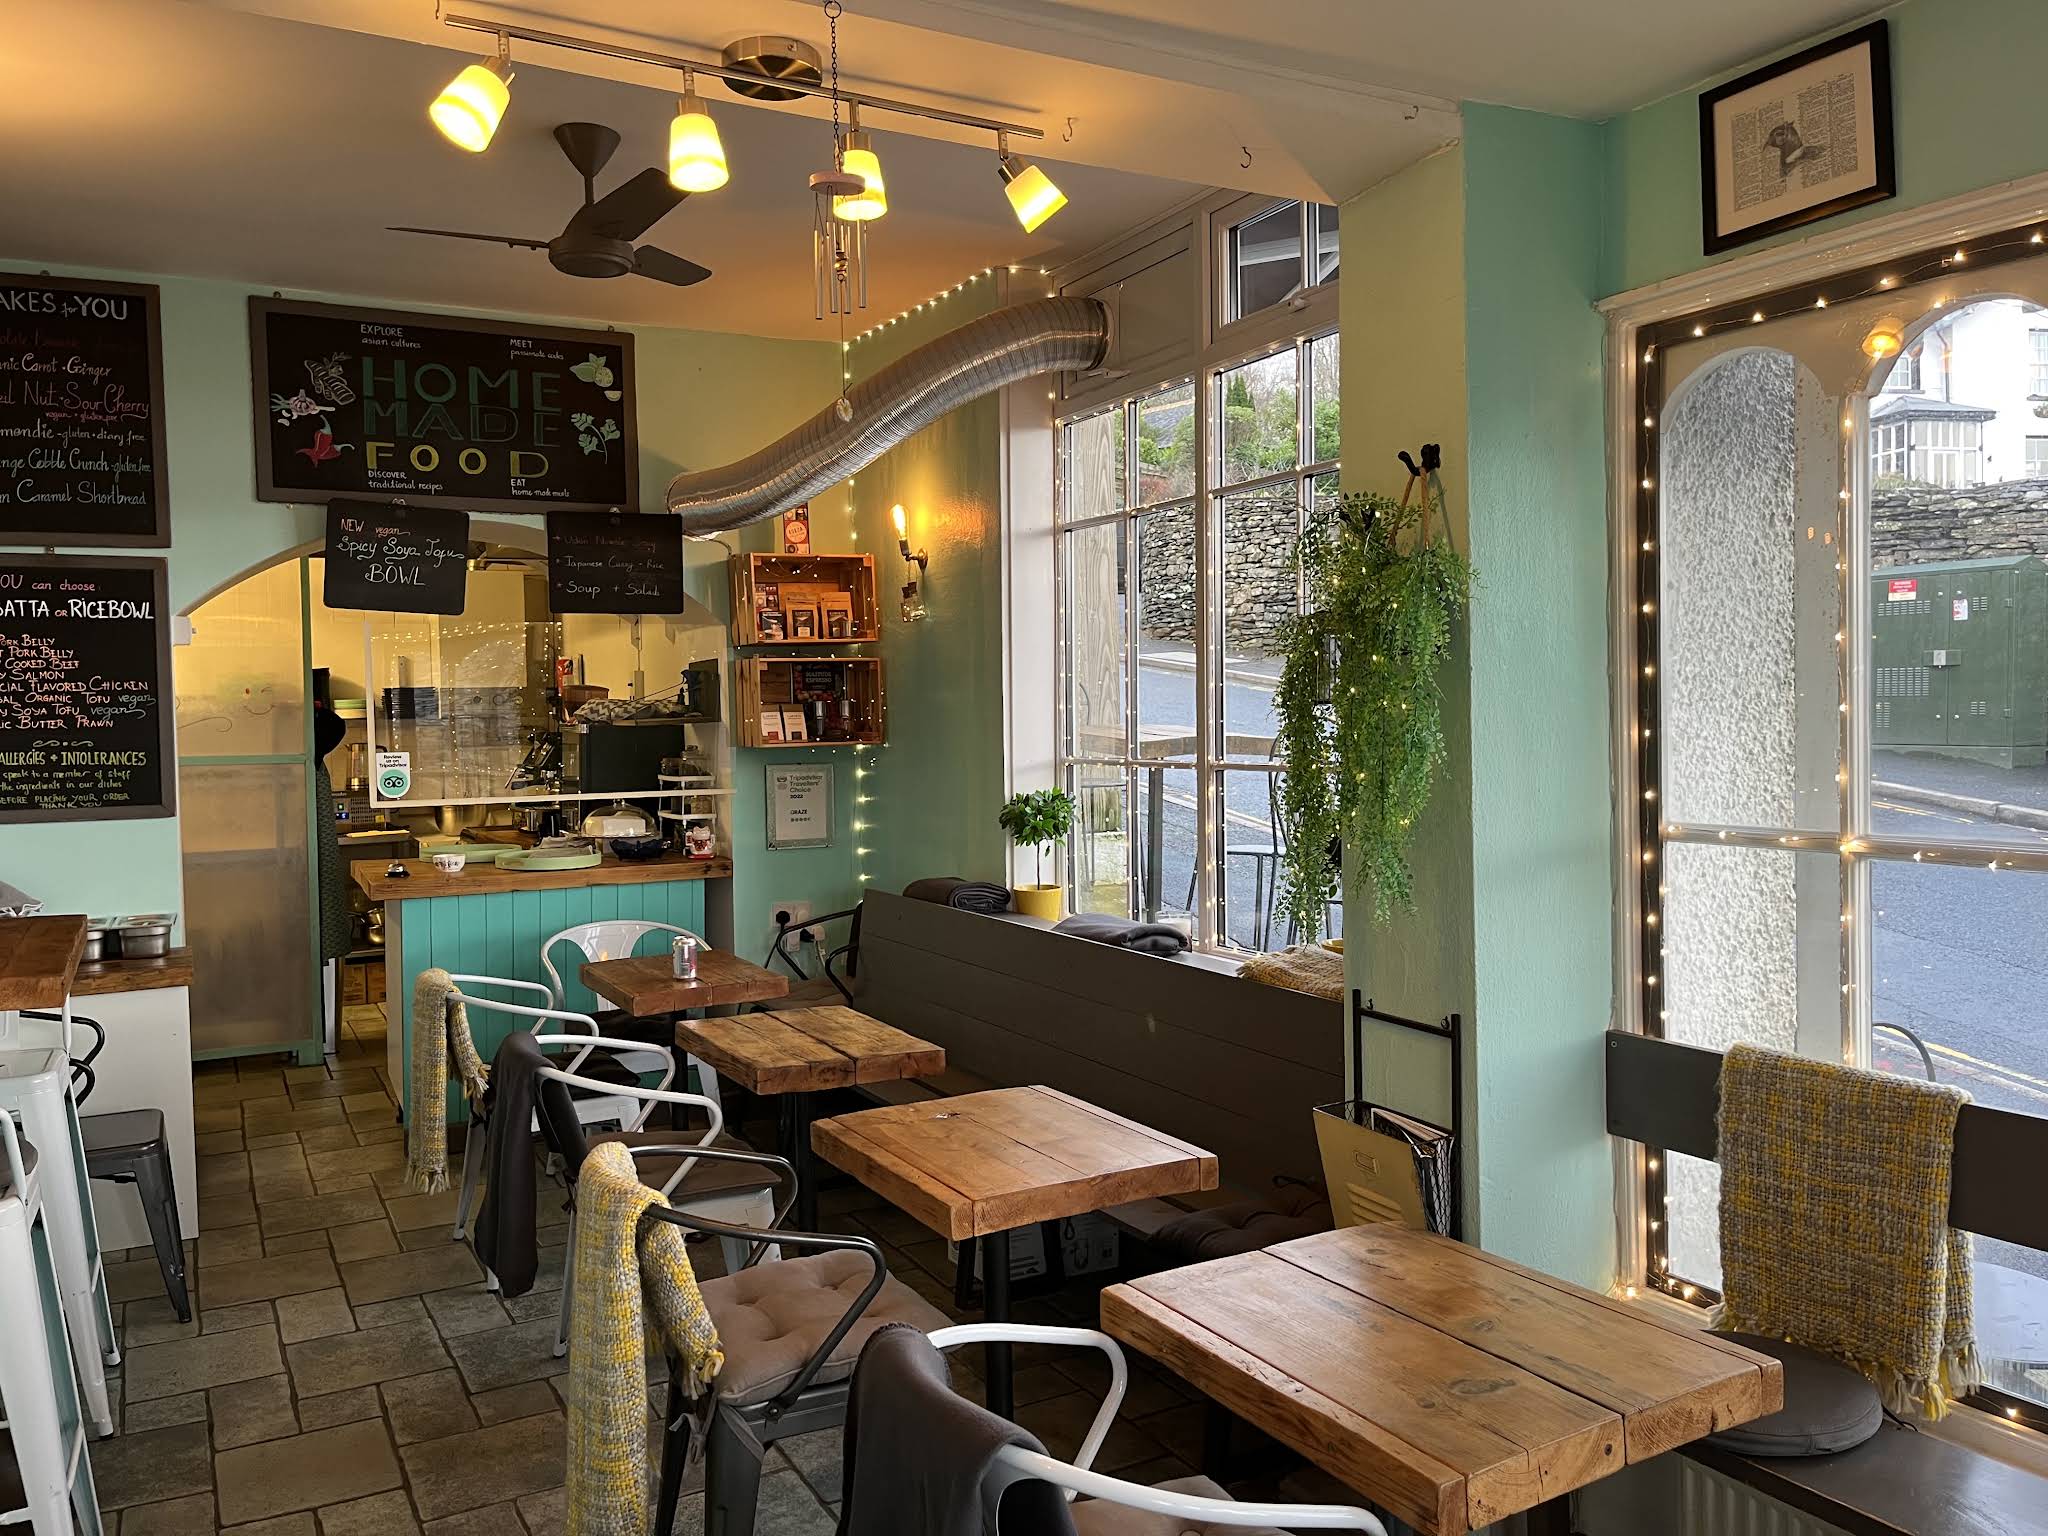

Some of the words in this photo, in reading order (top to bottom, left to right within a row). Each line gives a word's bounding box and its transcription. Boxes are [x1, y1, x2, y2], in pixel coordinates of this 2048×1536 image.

[62, 302, 78, 318] for
[73, 295, 128, 320] YOU
[360, 323, 403, 338] EXPLORE
[361, 337, 388, 346] asian
[390, 338, 422, 350] cultures
[509, 338, 533, 349] MEET
[22, 353, 58, 373] Carrot
[67, 355, 112, 385] Ginger
[361, 355, 561, 414] HOME
[24, 380, 59, 406] Nut
[63, 381, 103, 410] Sour
[103, 383, 150, 420] Cherry
[363, 400, 561, 448] MADE
[126, 430, 147, 446] free
[0, 458, 26, 478] nge
[69, 447, 109, 472] Crunch
[366, 441, 550, 479] FOOD
[368, 470, 408, 480] DISCOVER
[510, 478, 526, 487] EAT
[16, 478, 73, 503] Caramel
[77, 480, 147, 505] Shortbread
[368, 480, 416, 490] traditional
[418, 482, 444, 495] recipes
[511, 486, 533, 496] home
[340, 518, 364, 532] NEW
[375, 527, 411, 538] vegan
[336, 535, 377, 560] Spicy
[383, 536, 421, 564] Soya
[425, 538, 465, 568] Tofu
[561, 555, 603, 572] Japanese
[608, 555, 634, 573] Curry
[364, 563, 426, 586] BOWL
[31, 582, 52, 590] can
[59, 578, 96, 591] choose
[566, 580, 601, 599] Soup
[55, 609, 69, 617] OR
[68, 597, 154, 619] RICEBOWL
[21, 633, 56, 647] BELLY
[8, 646, 38, 658] PORK
[39, 646, 74, 659] BELLY
[5, 657, 46, 669] COOKED
[49, 657, 80, 670] BEEF
[9, 668, 65, 681] SALMON
[28, 680, 87, 692] FLAVORED
[89, 676, 149, 691] CHICKEN
[25, 691, 73, 703] ORGANIC
[81, 692, 111, 704] TOFU
[118, 693, 157, 709] vegan
[11, 703, 47, 717] SOYA
[51, 703, 80, 715] TOFU
[90, 706, 146, 720] vegan
[15, 715, 68, 730] BUTTER
[75, 714, 114, 729] PRAWN
[0, 749, 46, 766] ALLERGIES
[61, 750, 147, 766] INTOLERANCES
[2, 768, 29, 782] speak
[31, 769, 41, 778] to
[53, 768, 91, 778] member
[94, 769, 103, 780] of
[107, 768, 131, 780] staff
[0, 781, 14, 791] the
[16, 780, 61, 796] ingredients
[78, 781, 94, 789] our
[97, 778, 122, 789] dishes
[0, 796, 28, 804] EFORE
[35, 793, 67, 803] PLACING
[72, 793, 99, 804] YOUR
[103, 792, 130, 801] ORDER
[38, 801, 78, 809] THANK
